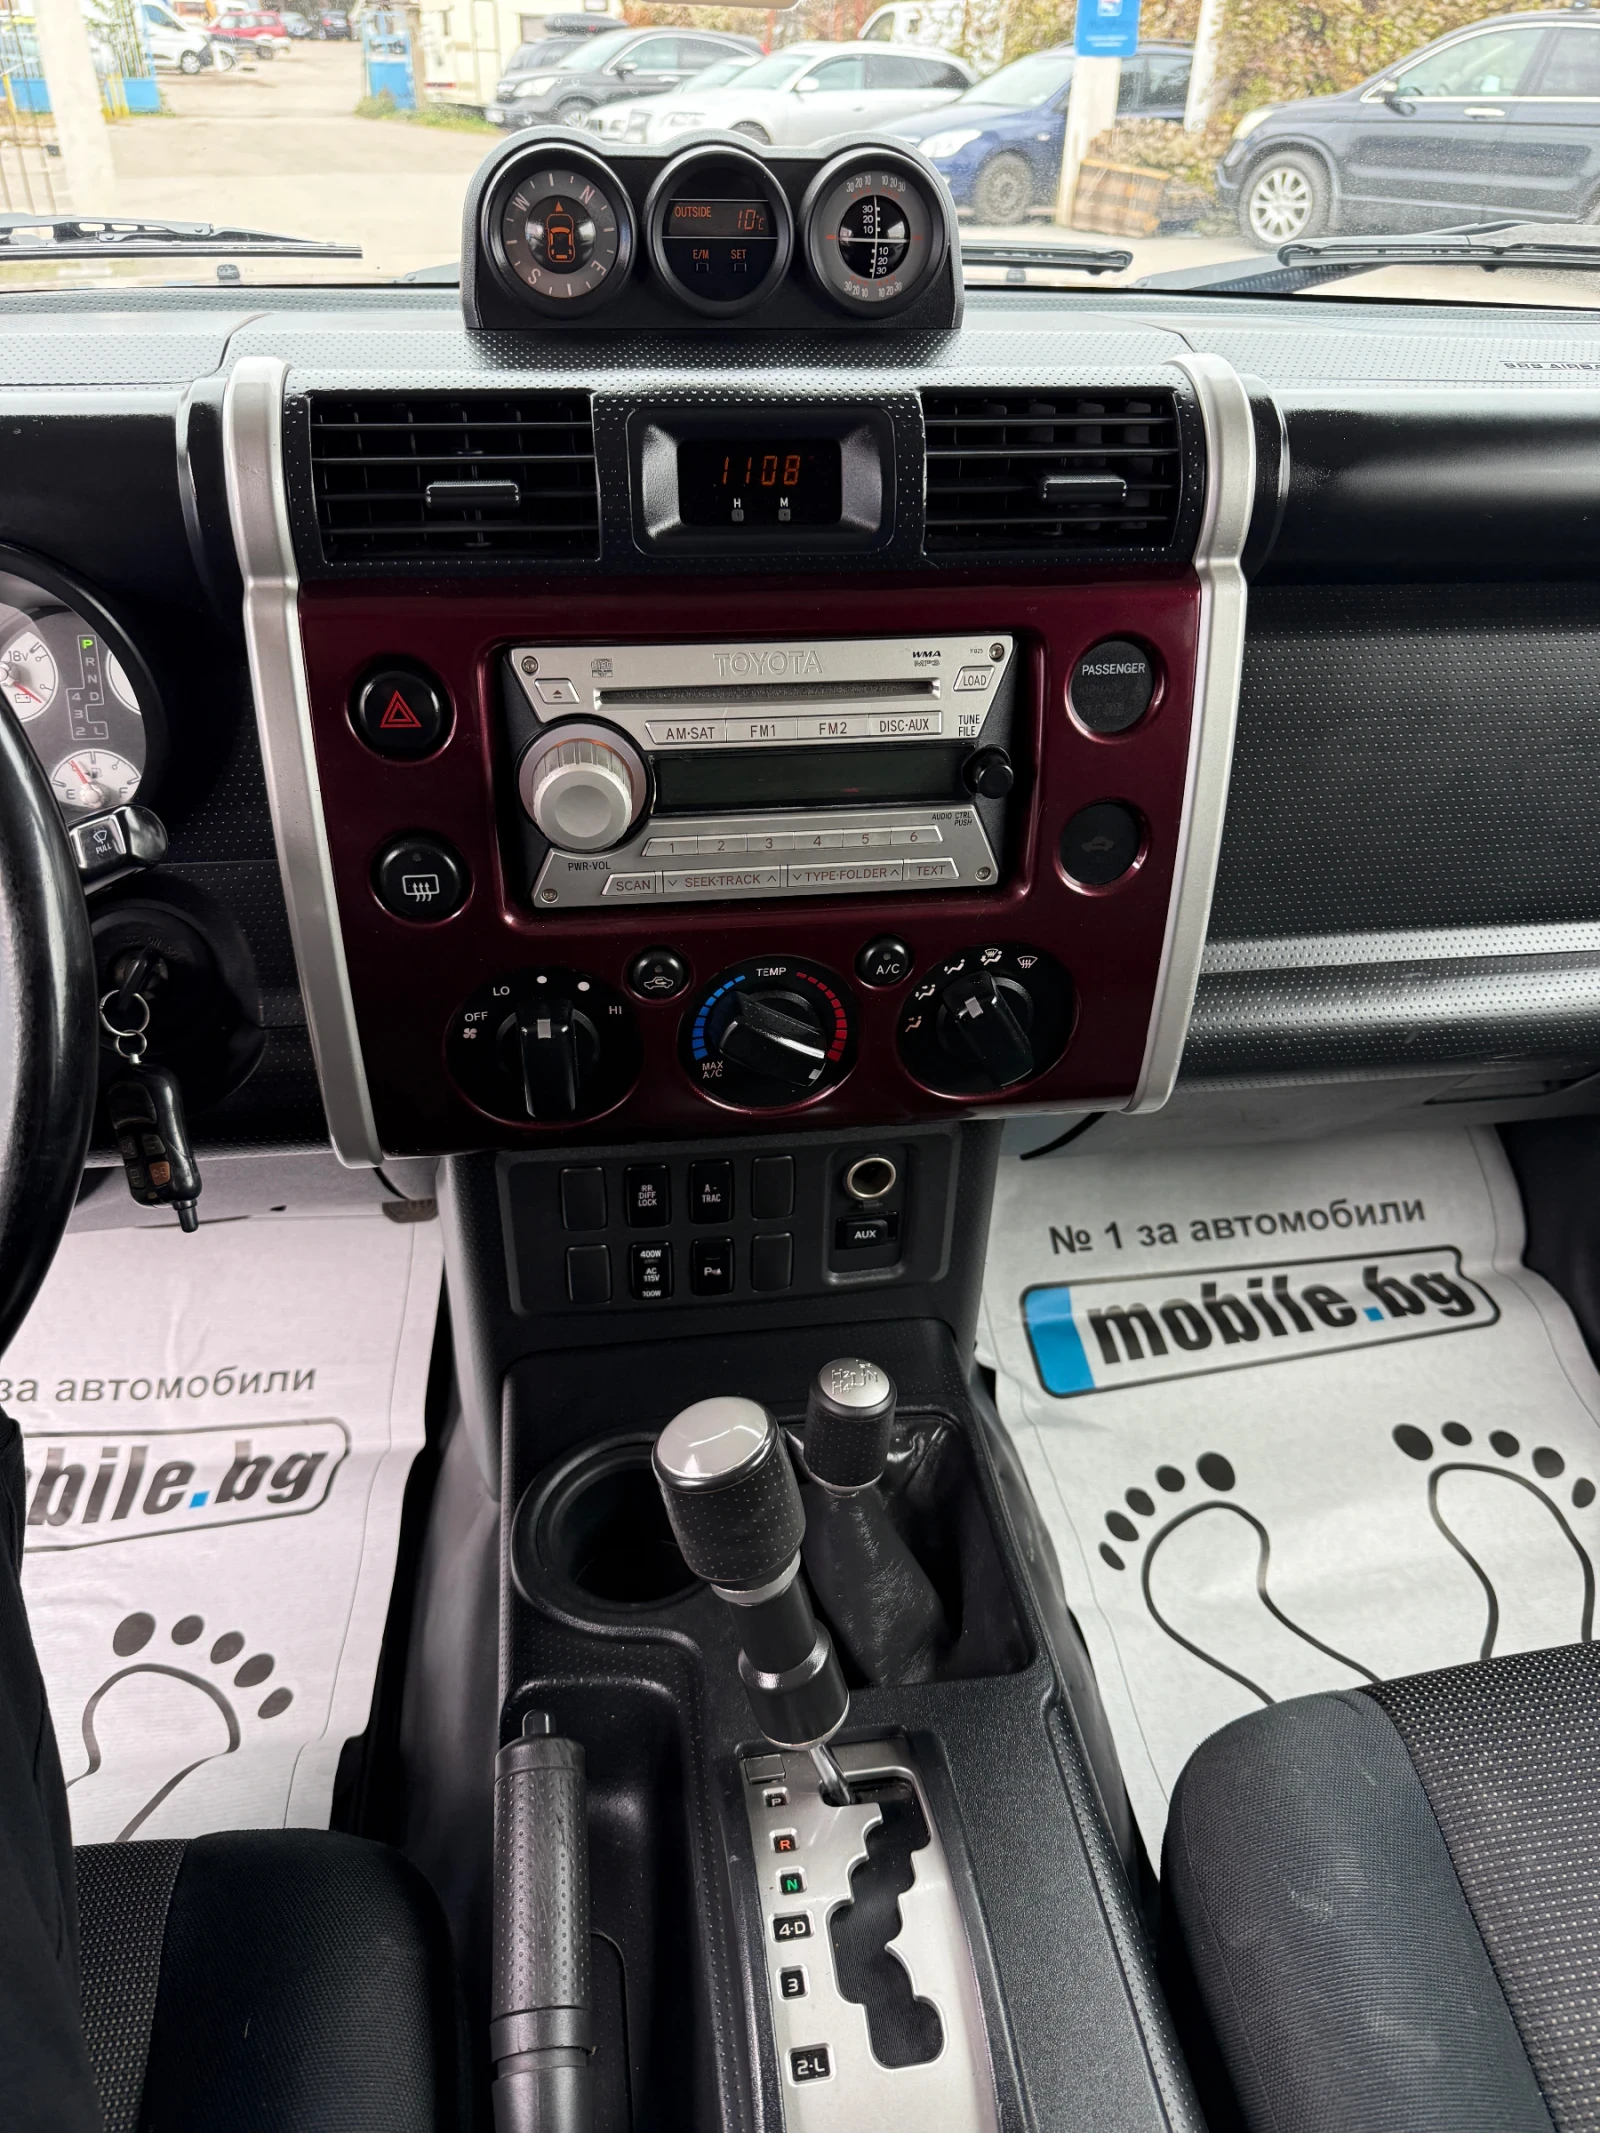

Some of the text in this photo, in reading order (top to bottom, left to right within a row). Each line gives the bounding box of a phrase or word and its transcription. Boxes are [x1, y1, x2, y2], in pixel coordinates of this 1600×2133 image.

[580, 185, 595, 204] N
[674, 206, 712, 218] OUTSIDE
[862, 205, 873, 213] 30
[863, 215, 873, 224] 20
[863, 225, 873, 234] 10
[693, 249, 709, 259] E/M
[731, 249, 747, 259] SET
[879, 247, 889, 255] 10
[878, 257, 888, 265] 20
[528, 268, 541, 284] S
[876, 267, 887, 275] 30
[733, 498, 741, 508] H
[780, 497, 788, 508] M
[82, 639, 93, 649] P
[912, 650, 941, 658] WMA
[85, 657, 95, 667] R
[713, 651, 823, 676] TOYOTA
[1082, 662, 1146, 675] PASSENGER
[87, 674, 98, 684] N
[963, 675, 987, 686] LOAD
[72, 692, 100, 701] 4 D
[74, 710, 83, 719] 3
[958, 714, 980, 725] TUNE
[75, 726, 104, 736] 2 L
[750, 724, 776, 738] FM1
[819, 722, 847, 735] FM2
[958, 726, 976, 737] FILE
[66, 789, 76, 800] E
[119, 787, 128, 798] F
[932, 811, 971, 820] AUDIO CTRL
[954, 819, 972, 827] PUSH
[813, 836, 822, 847] 4
[861, 833, 869, 844] 5
[910, 831, 918, 842] 6
[669, 842, 675, 853] 1
[717, 840, 725, 851] 2
[765, 838, 773, 849] 3
[95, 843, 112, 855] PULL
[916, 865, 946, 876] TEXT
[616, 880, 651, 891] SCAN
[756, 967, 787, 977] TEMP
[876, 963, 900, 975] A/C
[493, 986, 510, 996] LO
[608, 1005, 622, 1015] HI
[464, 1011, 488, 1022] OFF
[702, 1061, 724, 1071] MAX
[702, 1069, 723, 1079] A/C
[641, 1184, 653, 1192] RR
[638, 1191, 656, 1199] DIFF
[702, 1194, 721, 1203] TRAC
[638, 1199, 657, 1207] LOCK
[1104, 1221, 1124, 1249] 1
[1138, 1225, 1179, 1247] за
[1190, 1197, 1426, 1243] автомобили
[854, 1230, 876, 1239] AUX
[640, 1250, 661, 1258] 400W
[645, 1267, 657, 1275] AC
[643, 1274, 660, 1282] 115V
[642, 1290, 661, 1298] 100W
[1087, 1265, 1478, 1365] mobile.bg
[55, 1365, 317, 1402] автомобили
[25, 1439, 329, 1527] bile.bg
[772, 1798, 781, 1806] P
[780, 1840, 791, 1850] R
[787, 1879, 798, 1890] N
[787, 1978, 799, 1992] 3
